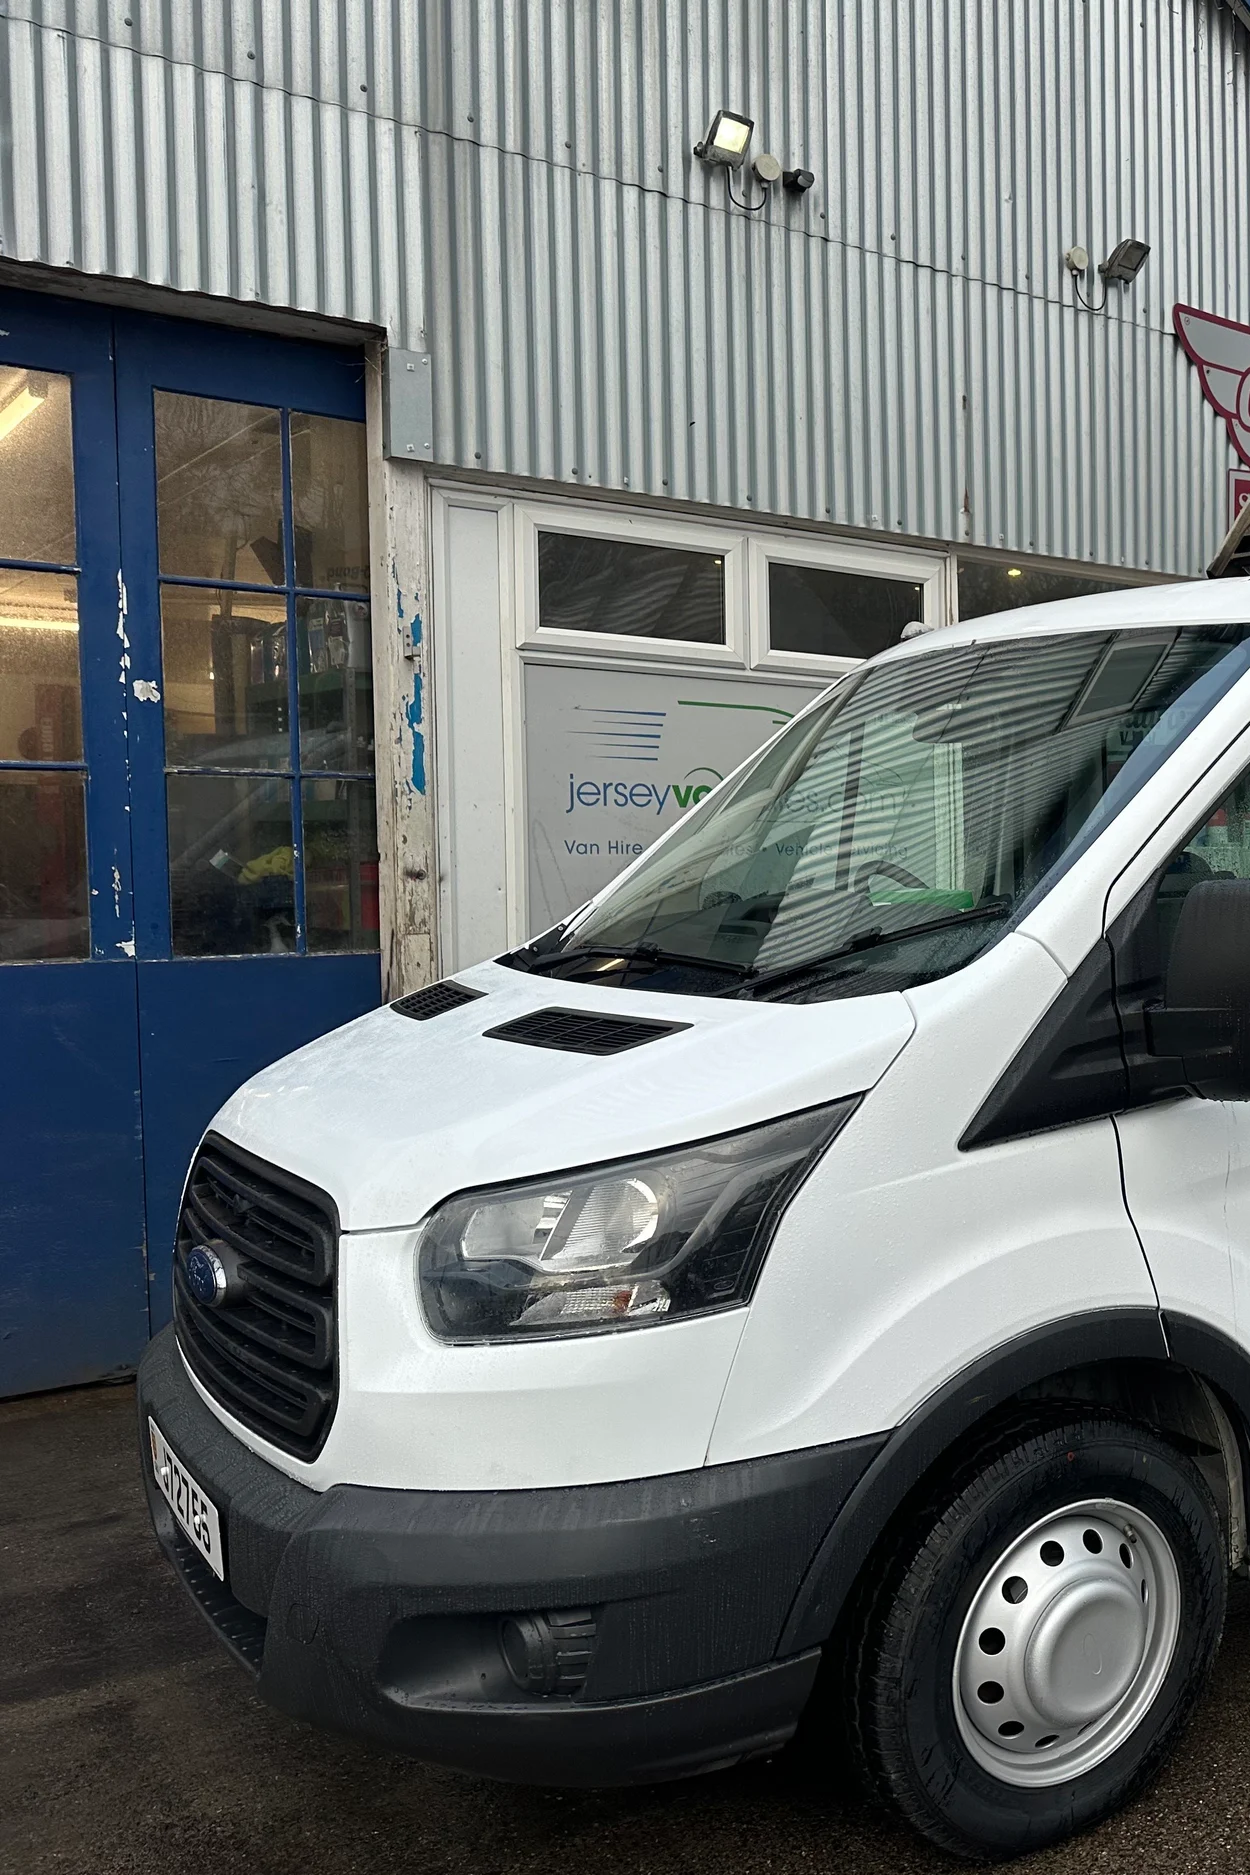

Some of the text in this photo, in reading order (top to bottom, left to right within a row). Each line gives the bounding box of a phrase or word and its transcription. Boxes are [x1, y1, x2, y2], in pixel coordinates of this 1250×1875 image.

[564, 840, 599, 855] Van
[608, 840, 643, 855] Hire
[775, 843, 833, 856] Vehicle
[842, 843, 908, 859] ervicing
